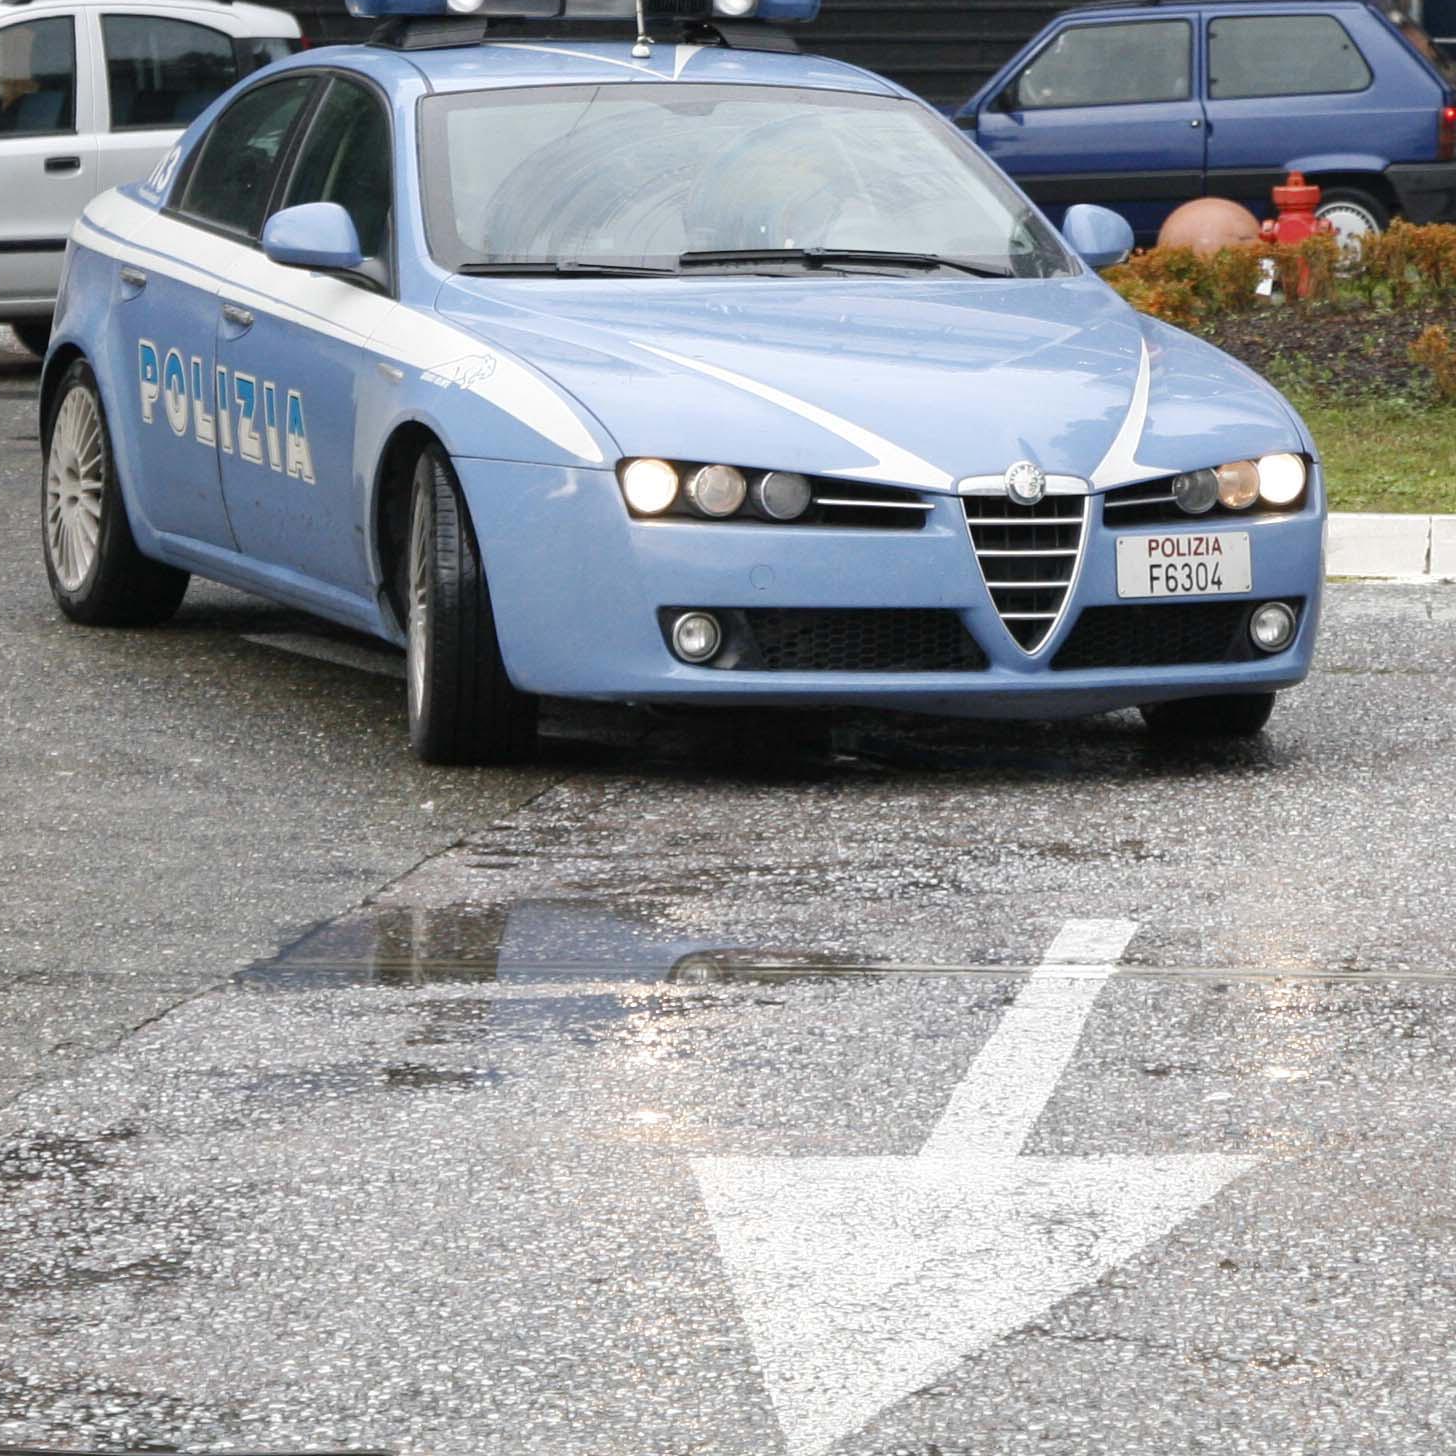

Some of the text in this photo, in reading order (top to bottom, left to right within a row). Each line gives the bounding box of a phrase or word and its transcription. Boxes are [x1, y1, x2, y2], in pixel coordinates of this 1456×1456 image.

[138, 337, 317, 486] POLIZIA
[1147, 536, 1224, 558] POLIZIA
[1148, 560, 1224, 594] F6304
